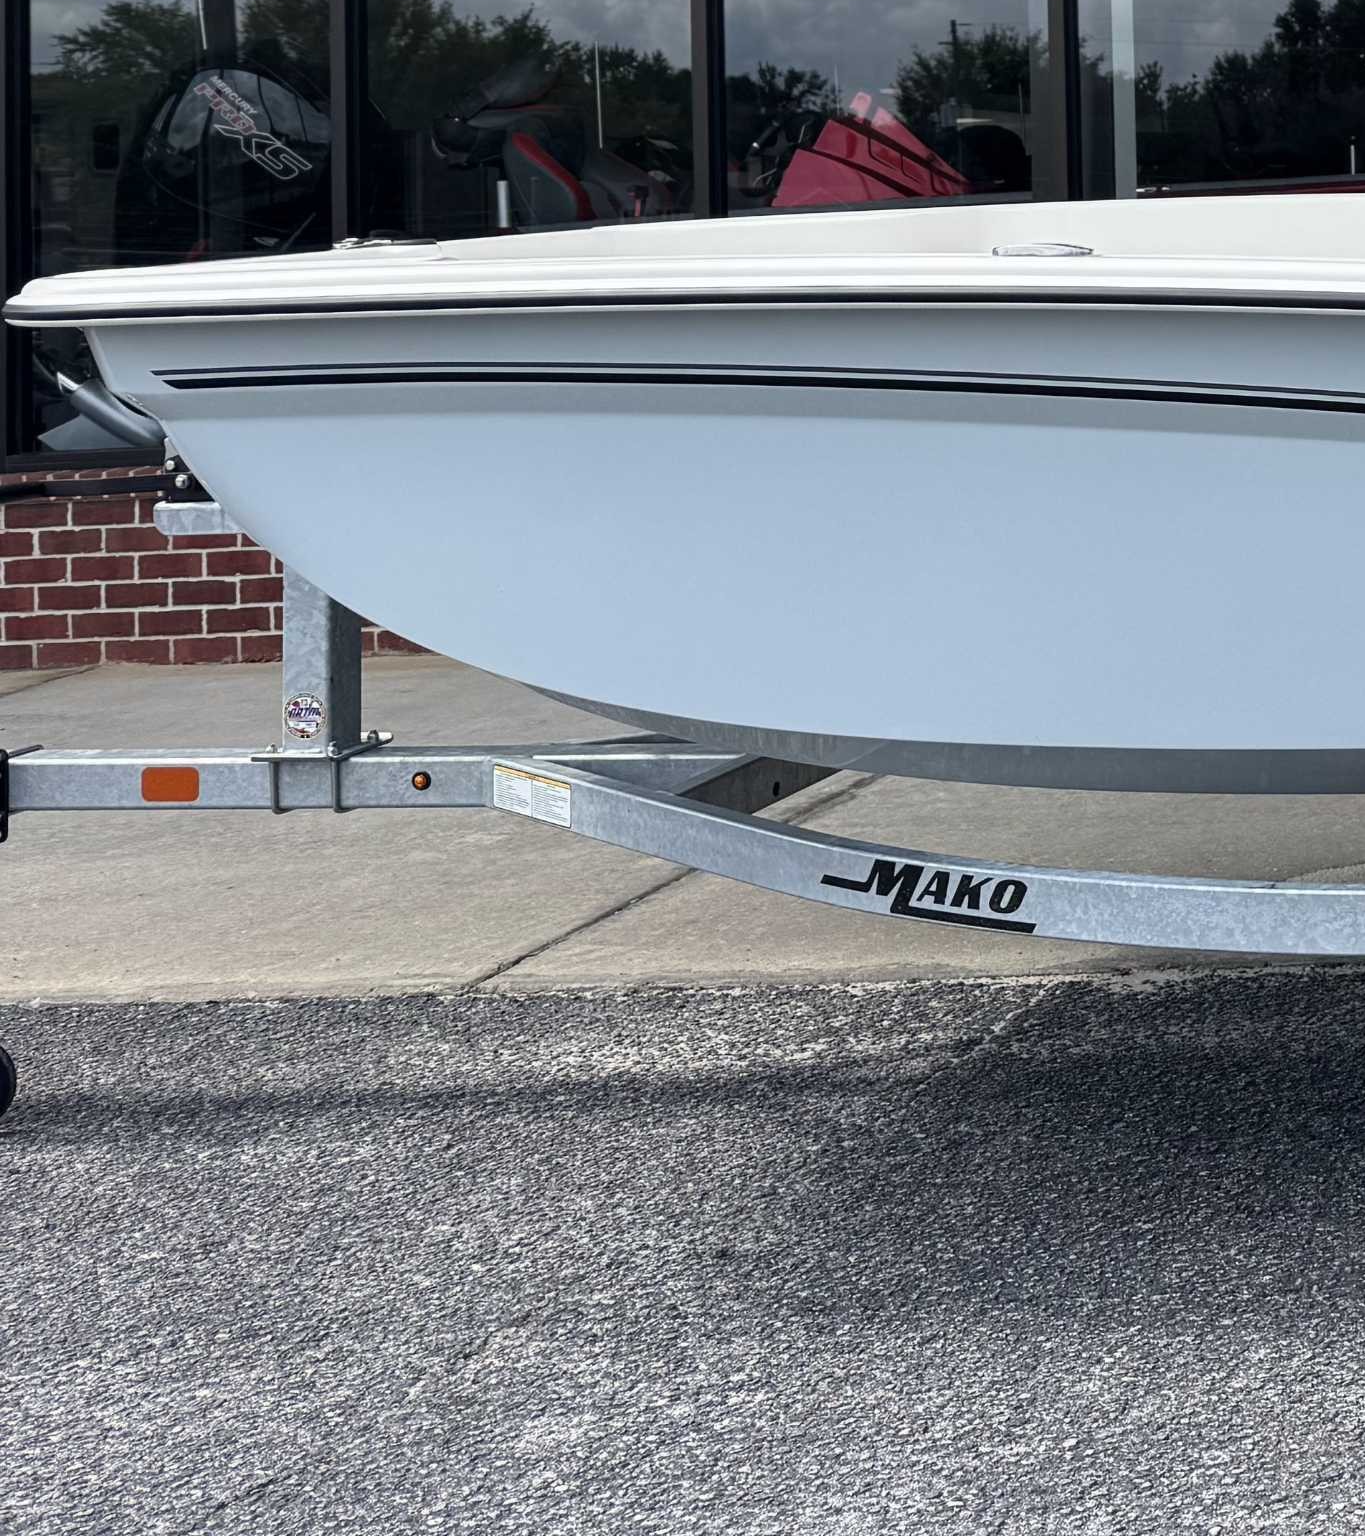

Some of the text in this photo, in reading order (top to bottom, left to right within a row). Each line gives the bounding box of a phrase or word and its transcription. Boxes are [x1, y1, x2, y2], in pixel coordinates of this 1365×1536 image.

[209, 75, 258, 115] MERCURY
[213, 123, 312, 180] XS
[820, 859, 1038, 934] MAKO
